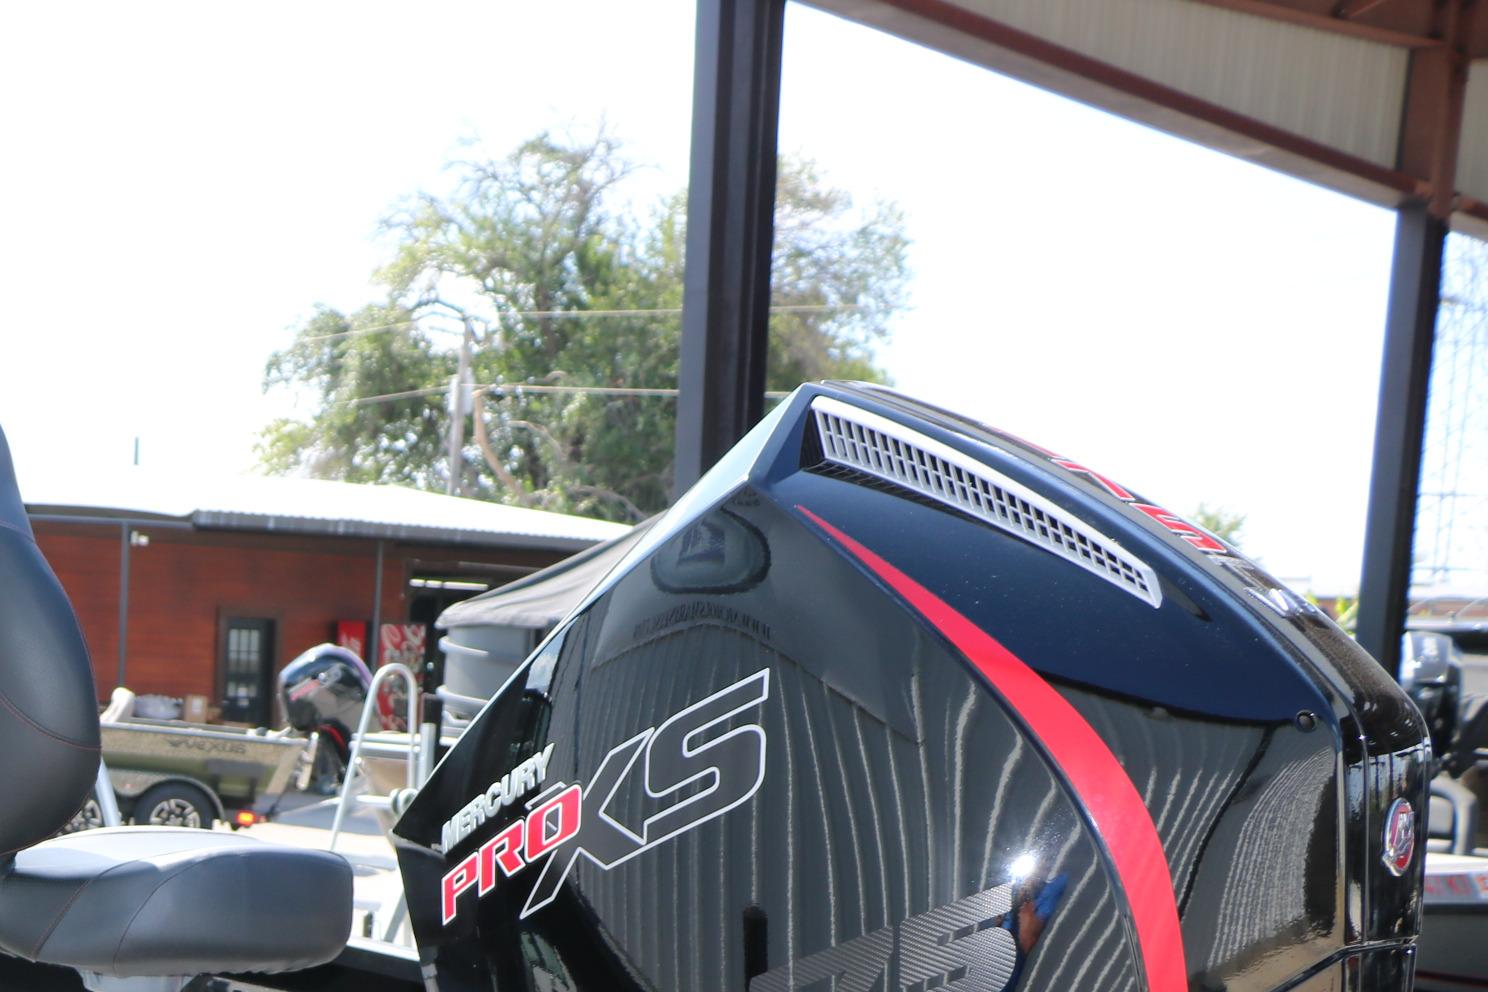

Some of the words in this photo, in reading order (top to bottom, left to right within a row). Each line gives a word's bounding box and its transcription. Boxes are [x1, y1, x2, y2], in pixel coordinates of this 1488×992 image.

[441, 783, 583, 926] PRO
[519, 667, 770, 920] XS
[441, 742, 555, 855] MERCURY
